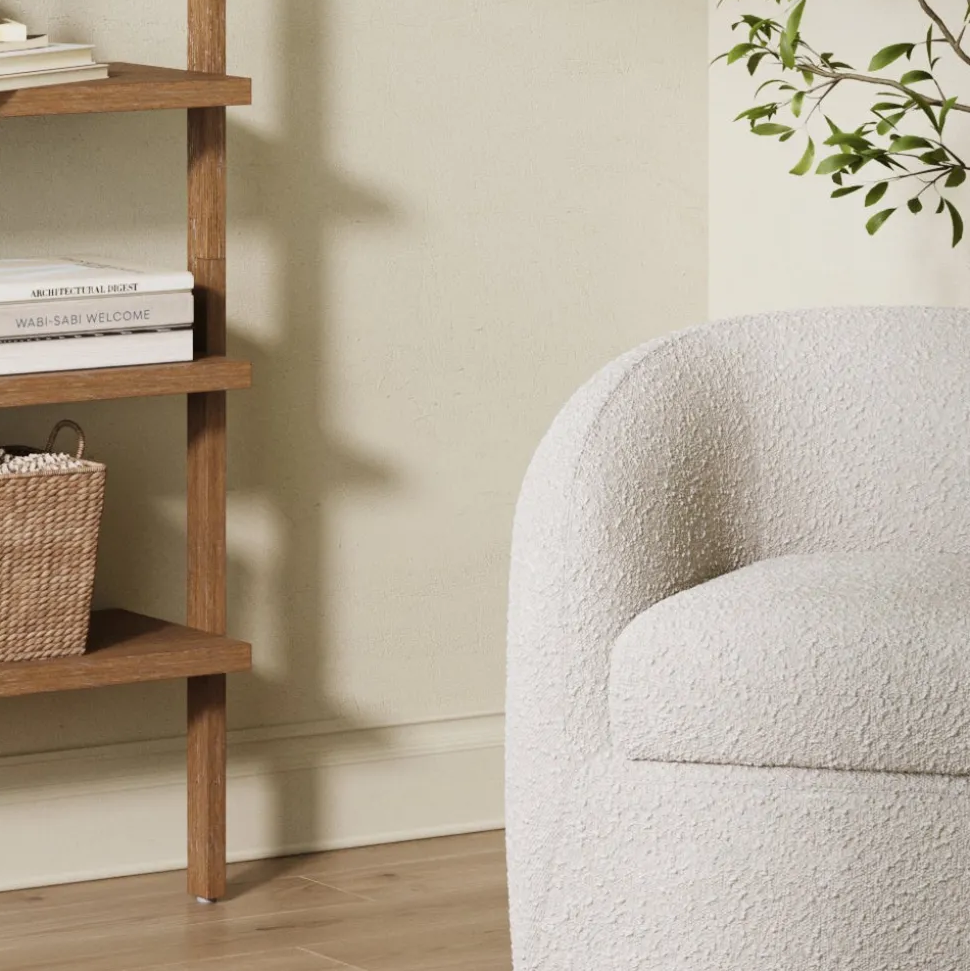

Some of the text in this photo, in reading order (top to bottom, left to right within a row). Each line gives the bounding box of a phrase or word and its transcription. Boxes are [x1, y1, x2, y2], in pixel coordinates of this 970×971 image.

[31, 283, 138, 298] ARCHITECTURAL DIGEST
[16, 309, 150, 328] WABI-SABI WELCOME
